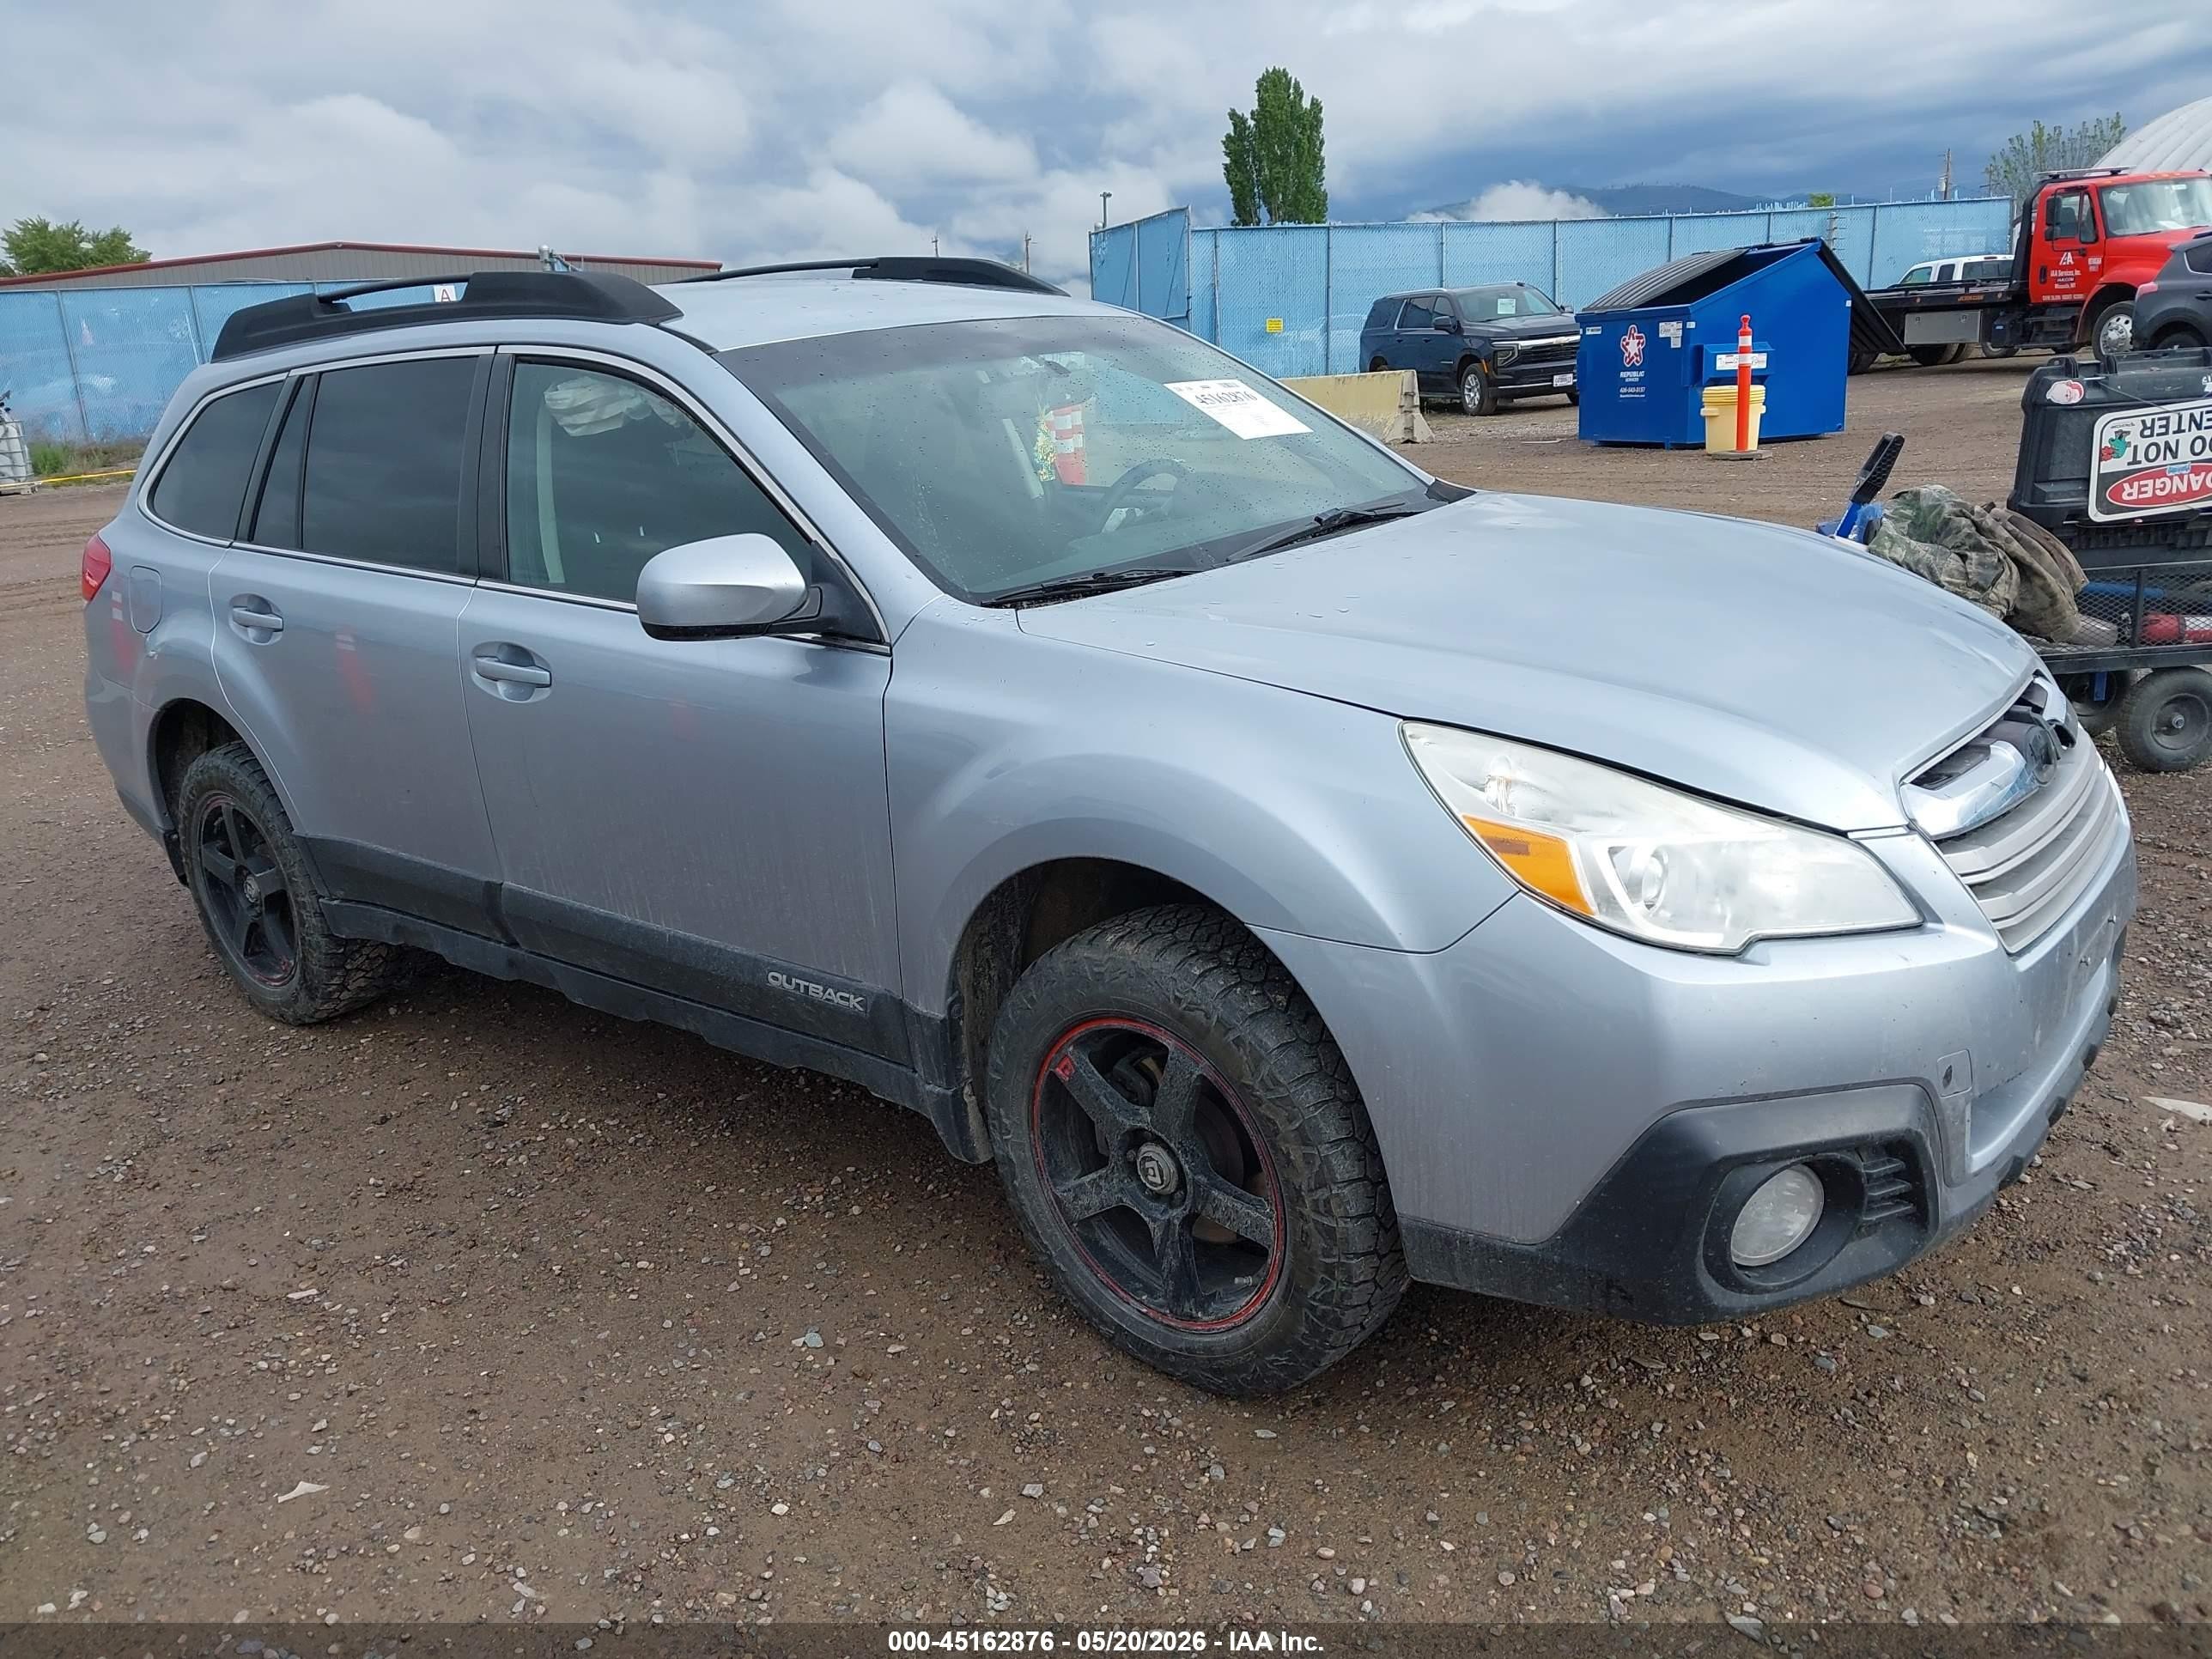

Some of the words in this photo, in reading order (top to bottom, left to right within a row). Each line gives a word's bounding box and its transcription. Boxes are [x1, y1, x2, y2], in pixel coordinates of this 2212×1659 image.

[441, 289, 451, 302] A
[1194, 392, 1258, 405] 45162876
[2126, 439, 2180, 466] NOT
[2191, 435, 2212, 455] O
[767, 971, 866, 1012] OUTBACK
